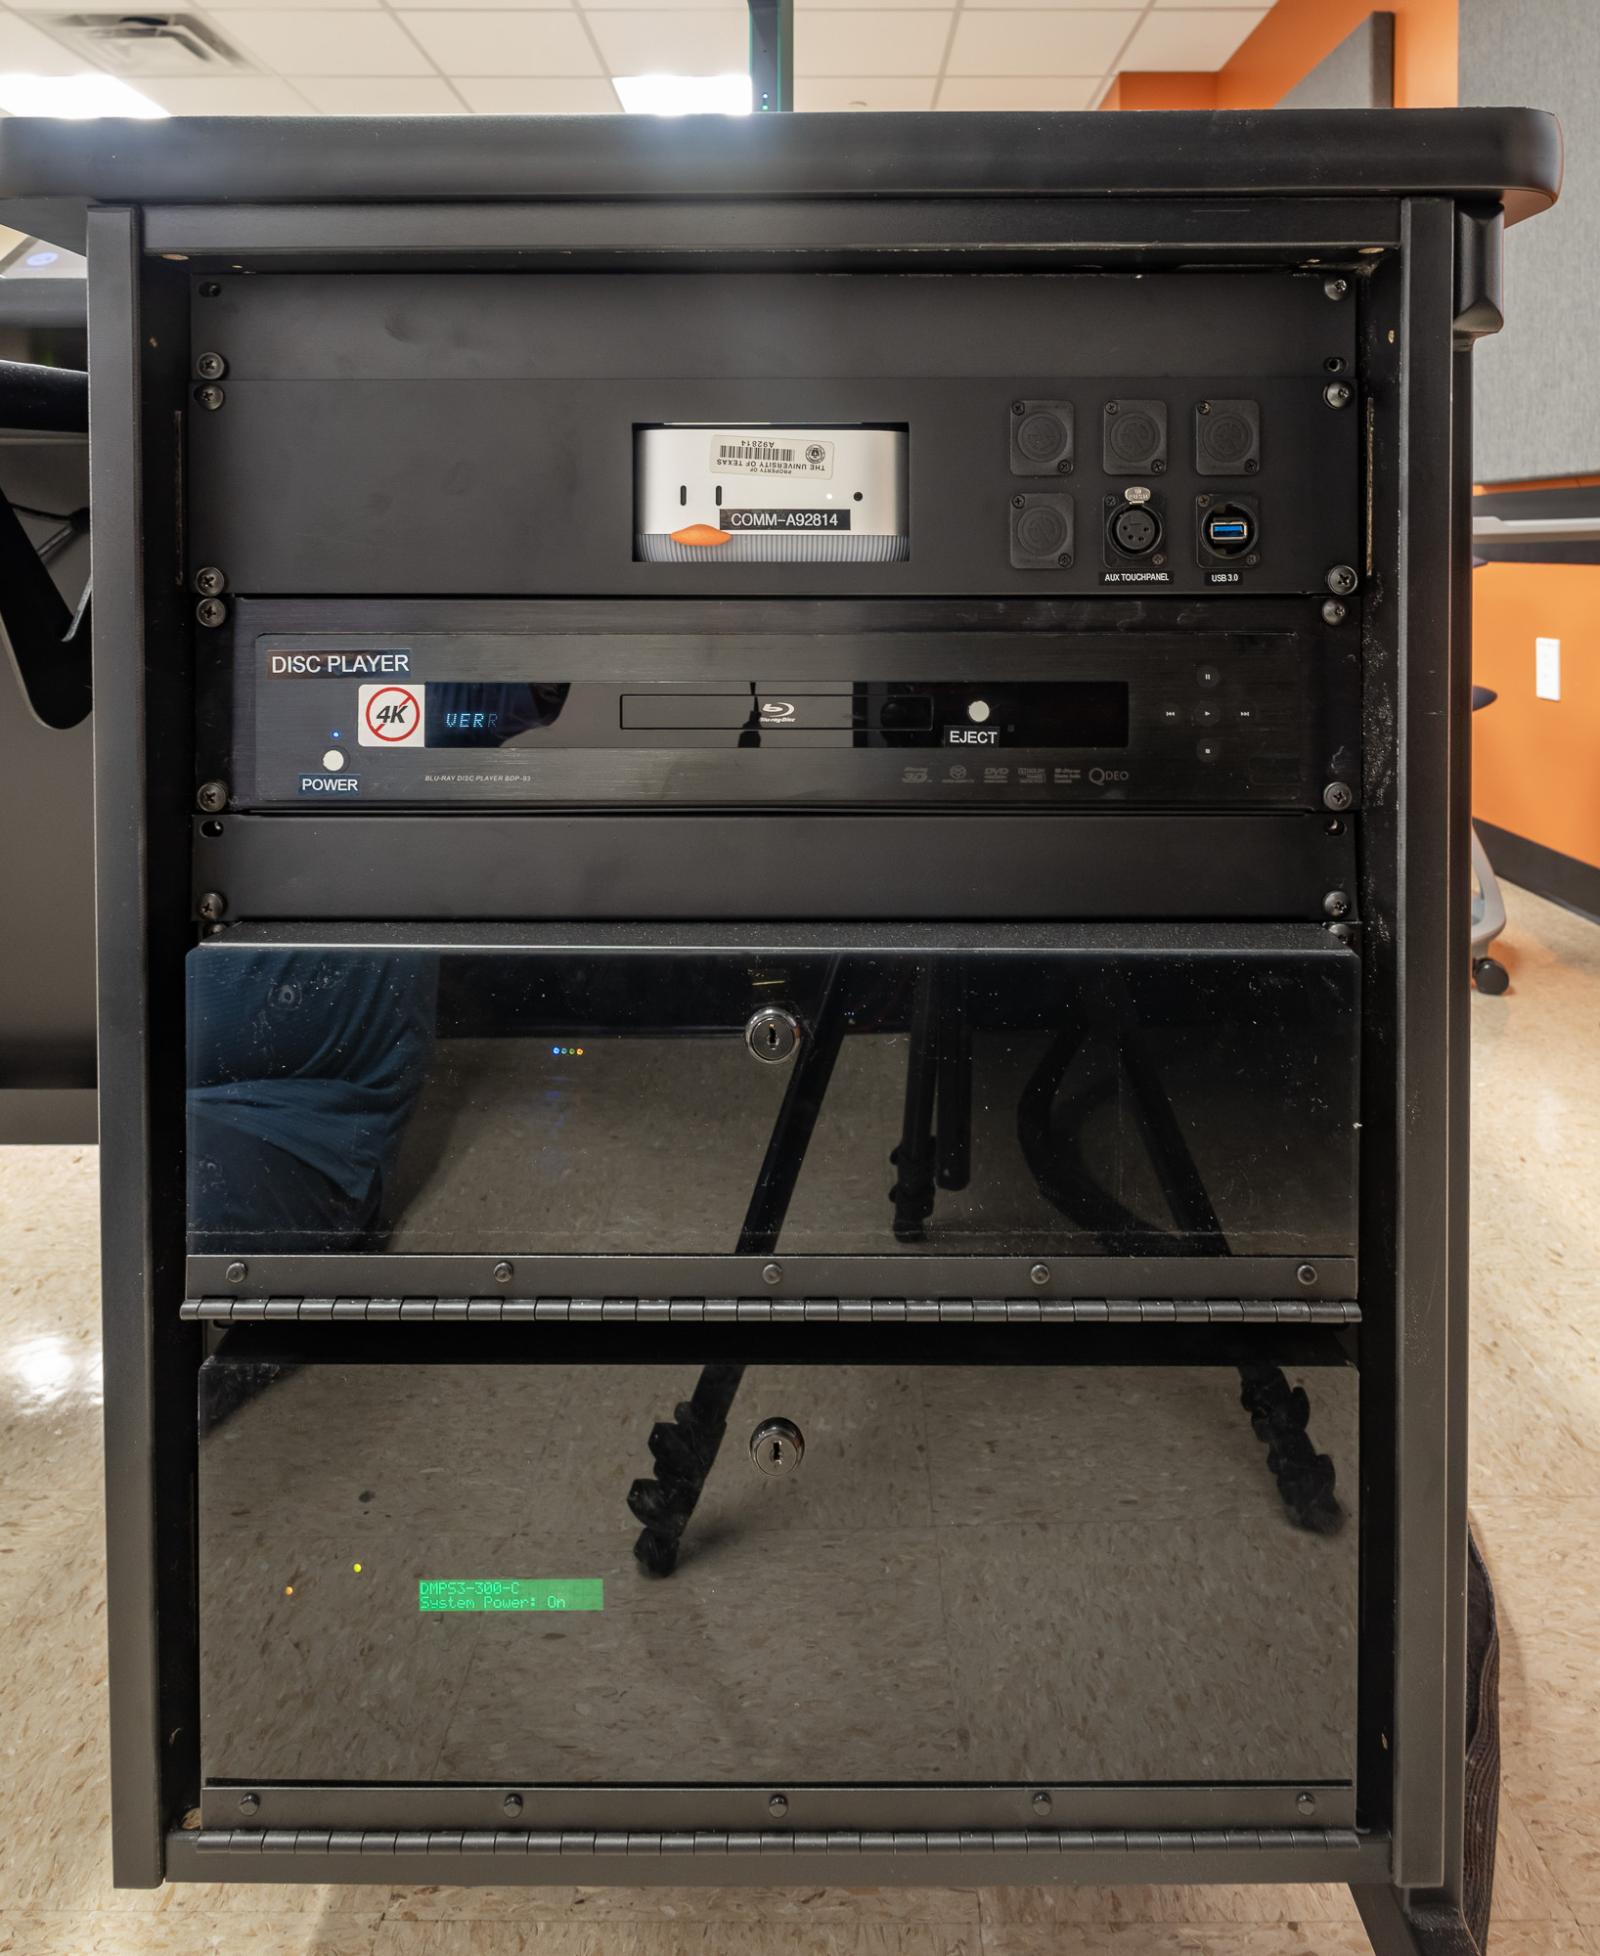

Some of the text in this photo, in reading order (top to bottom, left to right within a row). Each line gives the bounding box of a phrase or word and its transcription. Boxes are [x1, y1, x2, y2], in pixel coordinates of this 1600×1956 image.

[740, 440, 775, 448] A92814
[716, 458, 826, 472] THE UNIVERSITY OF TEXAS
[759, 467, 792, 475] PROPERTY
[730, 512, 838, 527] COMM-A92814
[1104, 572, 1170, 582] AUX TOUCHPANEL
[1211, 574, 1239, 582] USB 3.0
[271, 654, 410, 674] DISC PLAYER
[376, 705, 409, 724] 4K
[949, 730, 998, 745] EJECT
[301, 777, 358, 791] POWER
[419, 1581, 521, 1595] DMPS3-300-C
[419, 1595, 566, 1610] System Power: On
